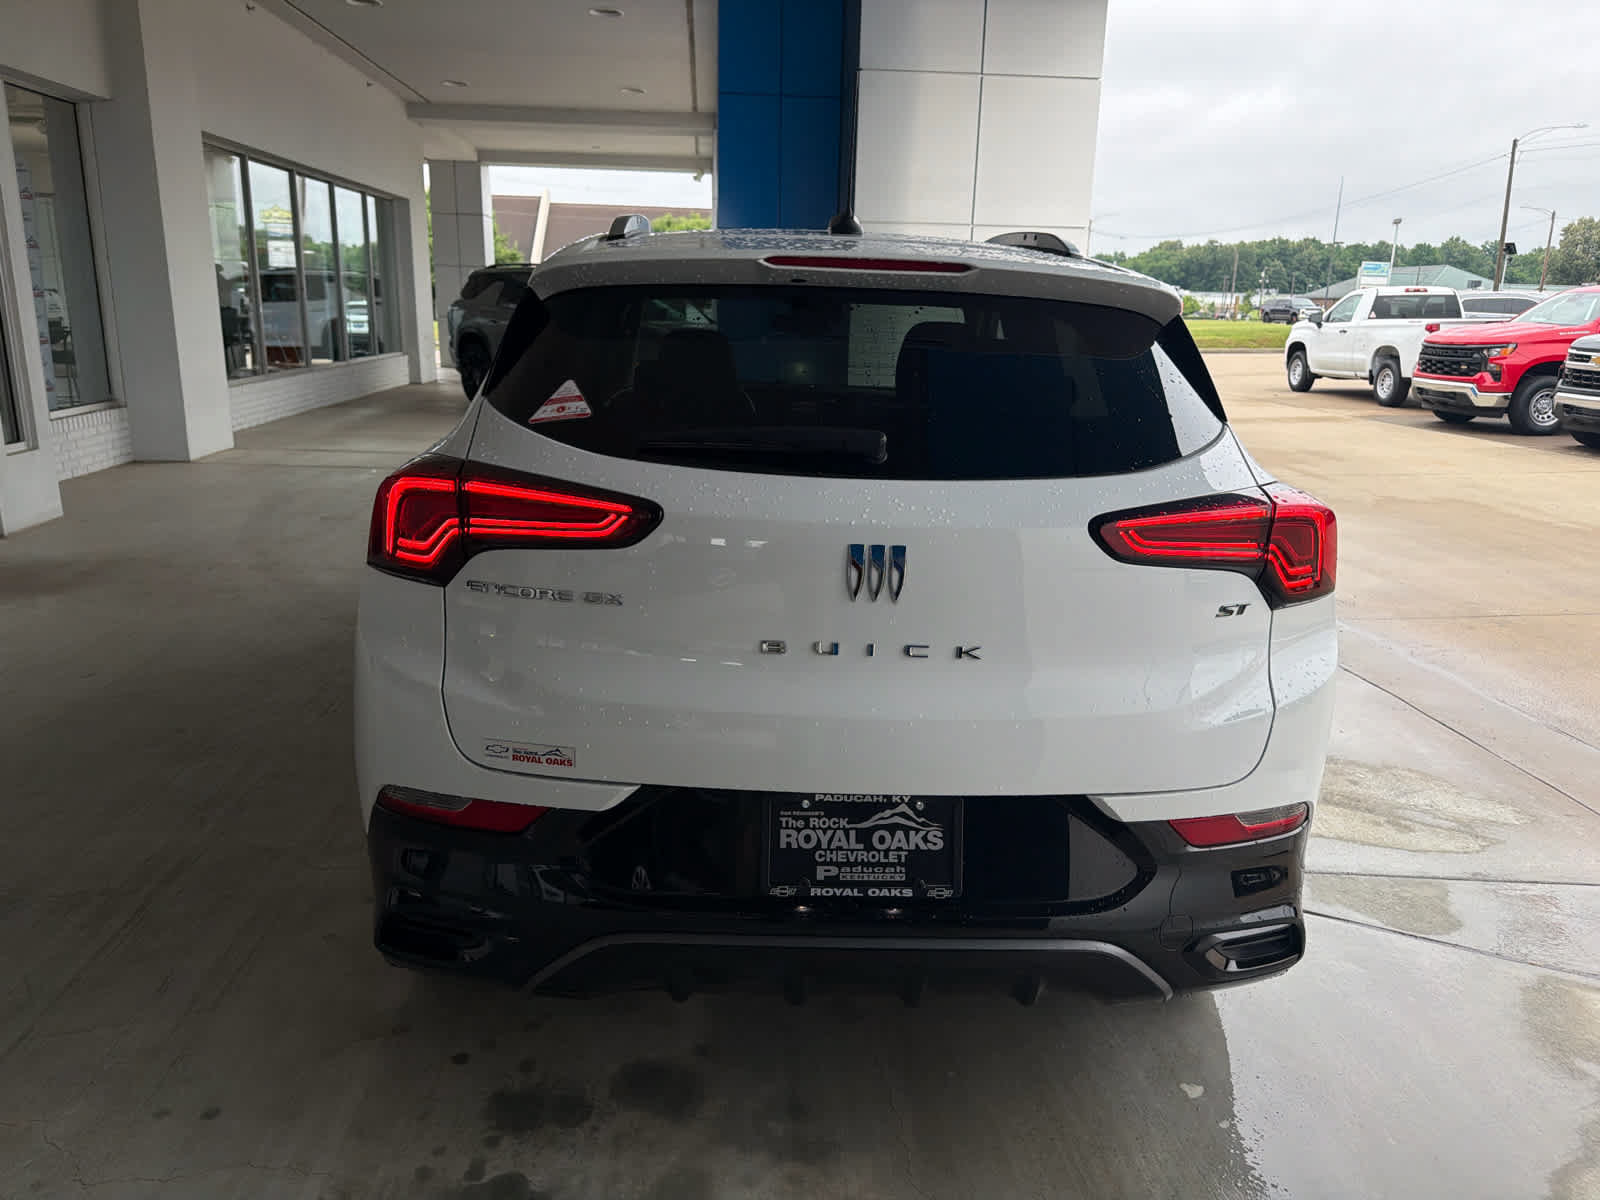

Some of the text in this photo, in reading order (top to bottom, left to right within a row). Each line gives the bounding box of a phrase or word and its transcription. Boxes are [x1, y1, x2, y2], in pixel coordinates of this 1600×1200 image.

[466, 580, 623, 606] ENCORE GX
[1215, 603, 1251, 617] ST
[760, 640, 981, 659] BUICK
[512, 754, 543, 764] ROYAL
[545, 757, 573, 767] OAKS
[892, 795, 911, 803] KY
[779, 817, 849, 828] The ROCK
[779, 829, 944, 850] ROYAL OAKS
[814, 851, 908, 862] CHEVROLET
[810, 888, 913, 897] ROYAL OAKS
